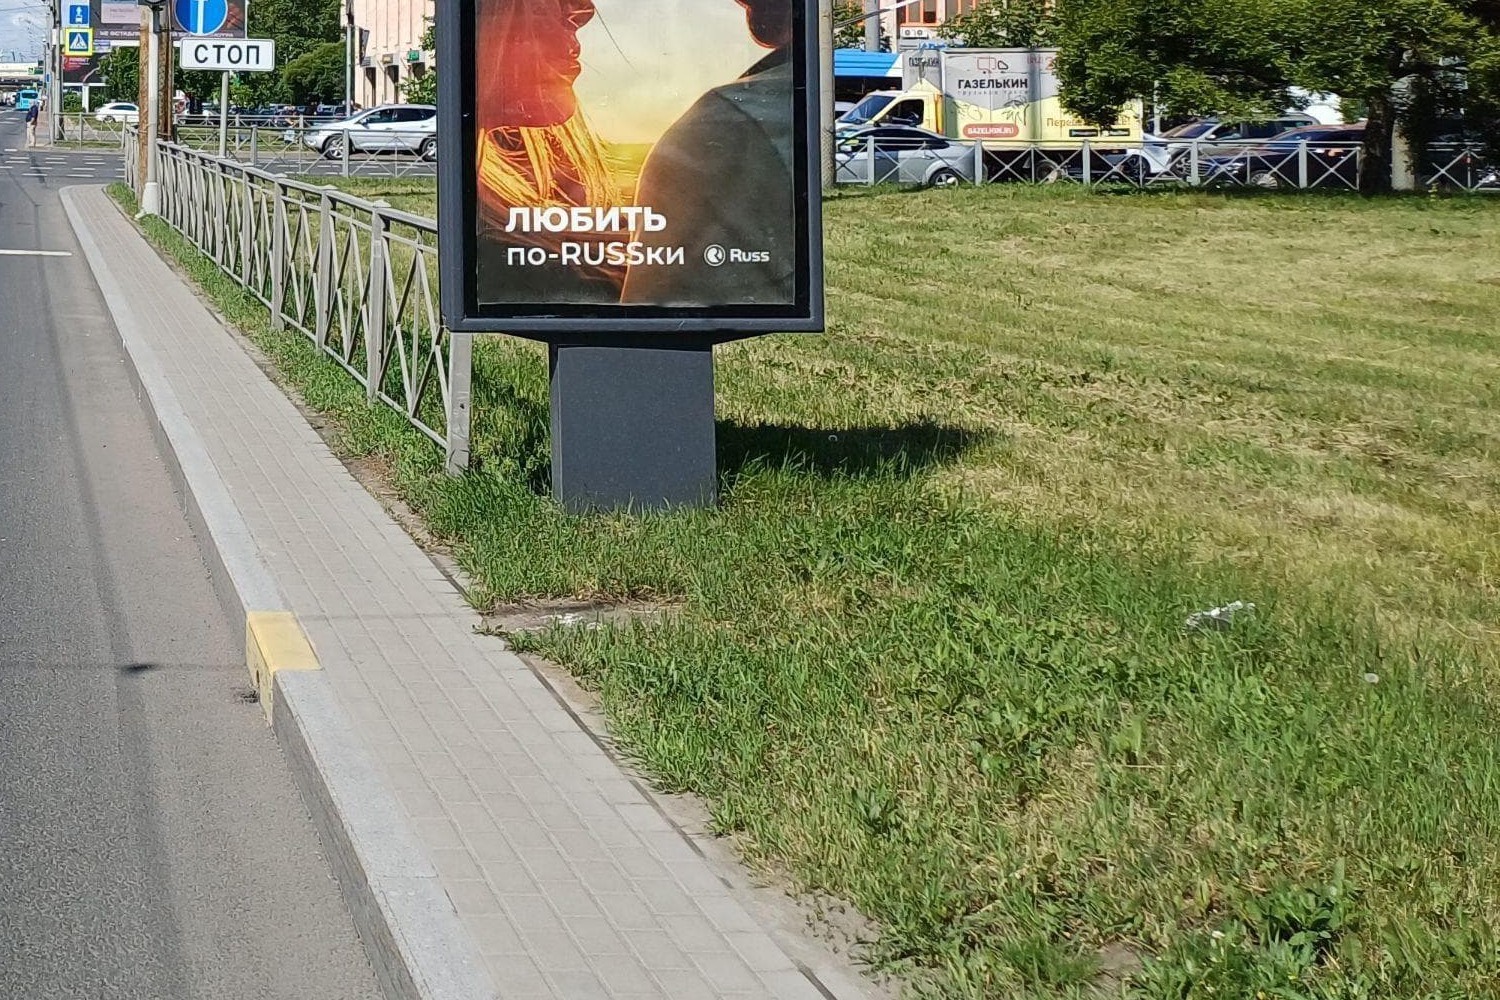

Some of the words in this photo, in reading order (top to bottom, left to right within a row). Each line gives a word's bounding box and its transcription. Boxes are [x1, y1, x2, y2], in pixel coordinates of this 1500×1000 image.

[194, 44, 260, 65] СТОП
[958, 78, 1028, 89] ГАЗЕЛЬКИН
[505, 206, 667, 233] ЛЮБИТЬ
[507, 241, 685, 266] по-RUSSки
[730, 248, 770, 263] Russ
